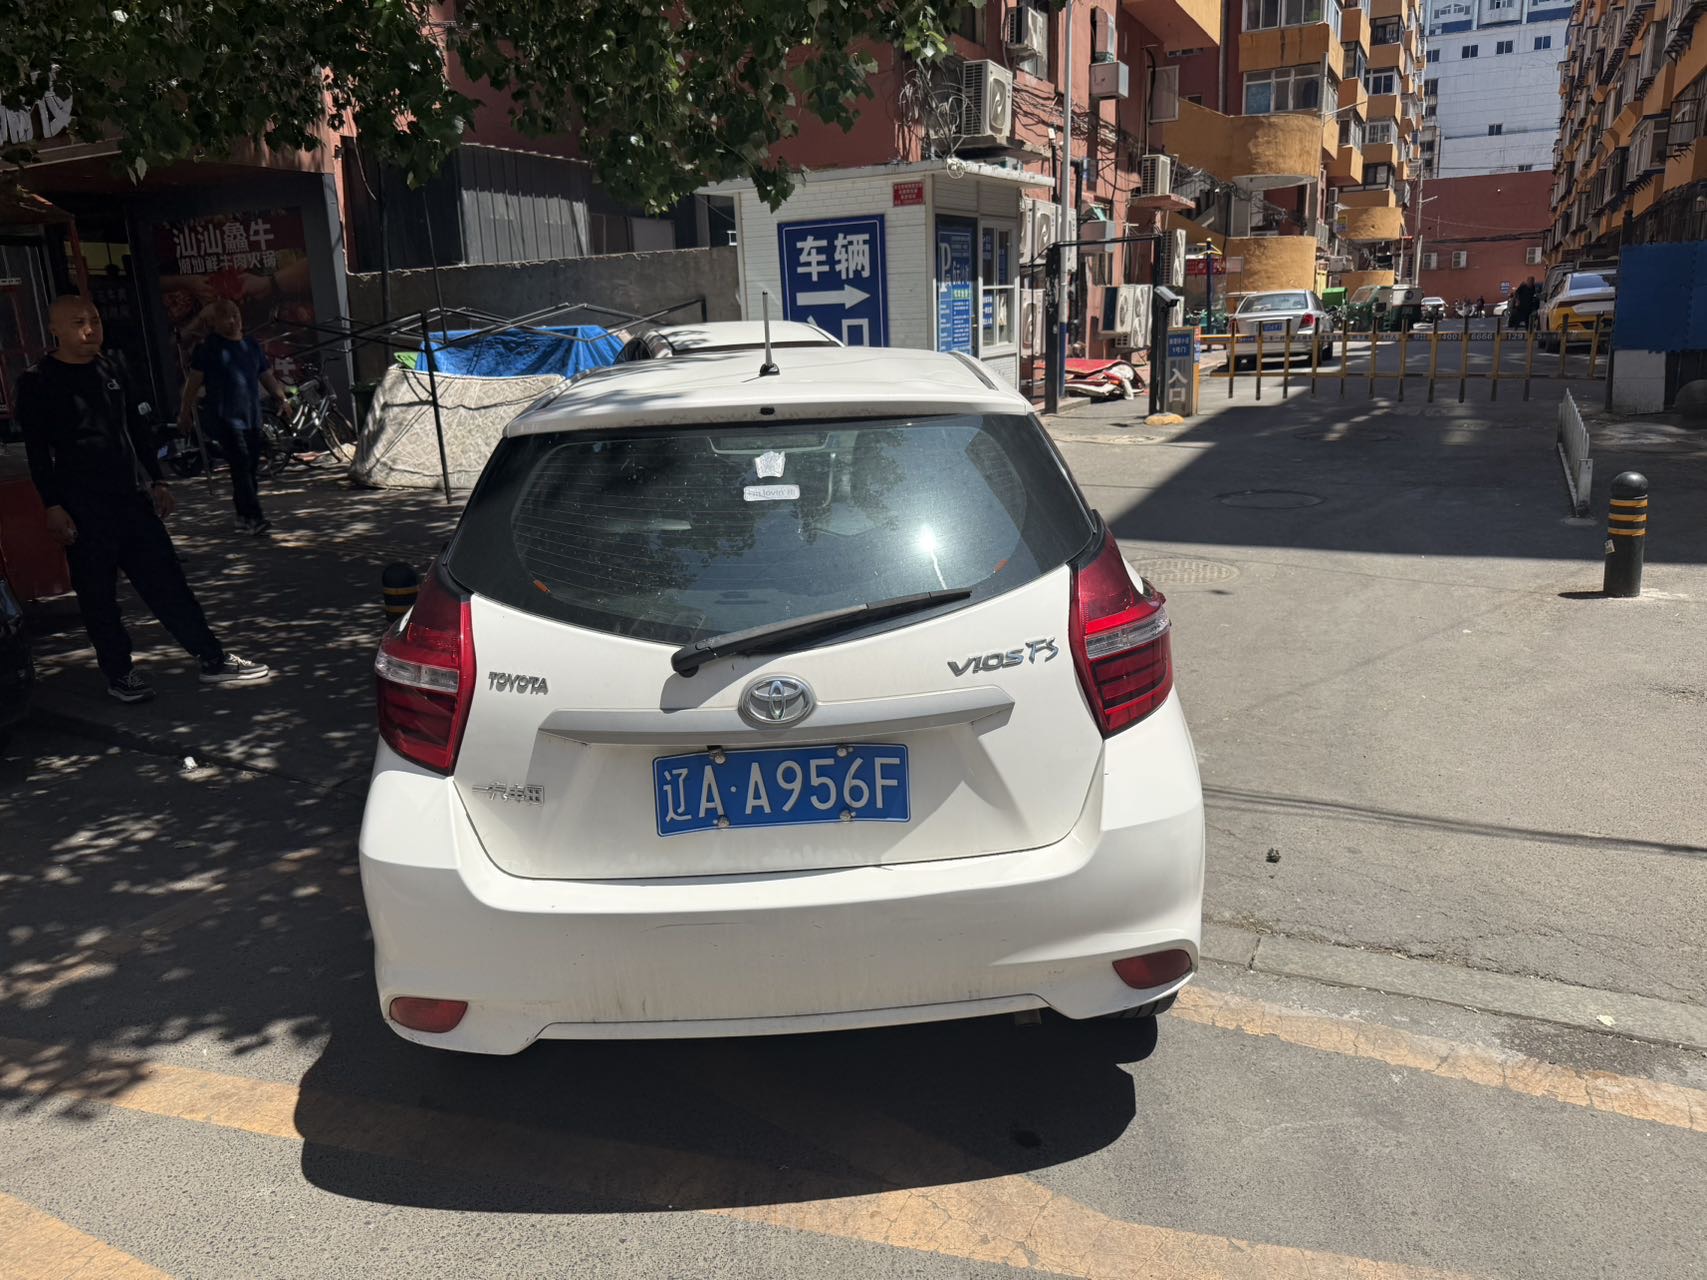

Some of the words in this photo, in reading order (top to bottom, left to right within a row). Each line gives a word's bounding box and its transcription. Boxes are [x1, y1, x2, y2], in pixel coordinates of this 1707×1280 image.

[796, 233, 870, 281] 车辆
[806, 315, 870, 347] 口
[1168, 368, 1188, 403] 入口
[947, 648, 1024, 677] VIOS
[488, 671, 549, 695] TOYOTA
[663, 757, 900, 822] 辽A·A956F
